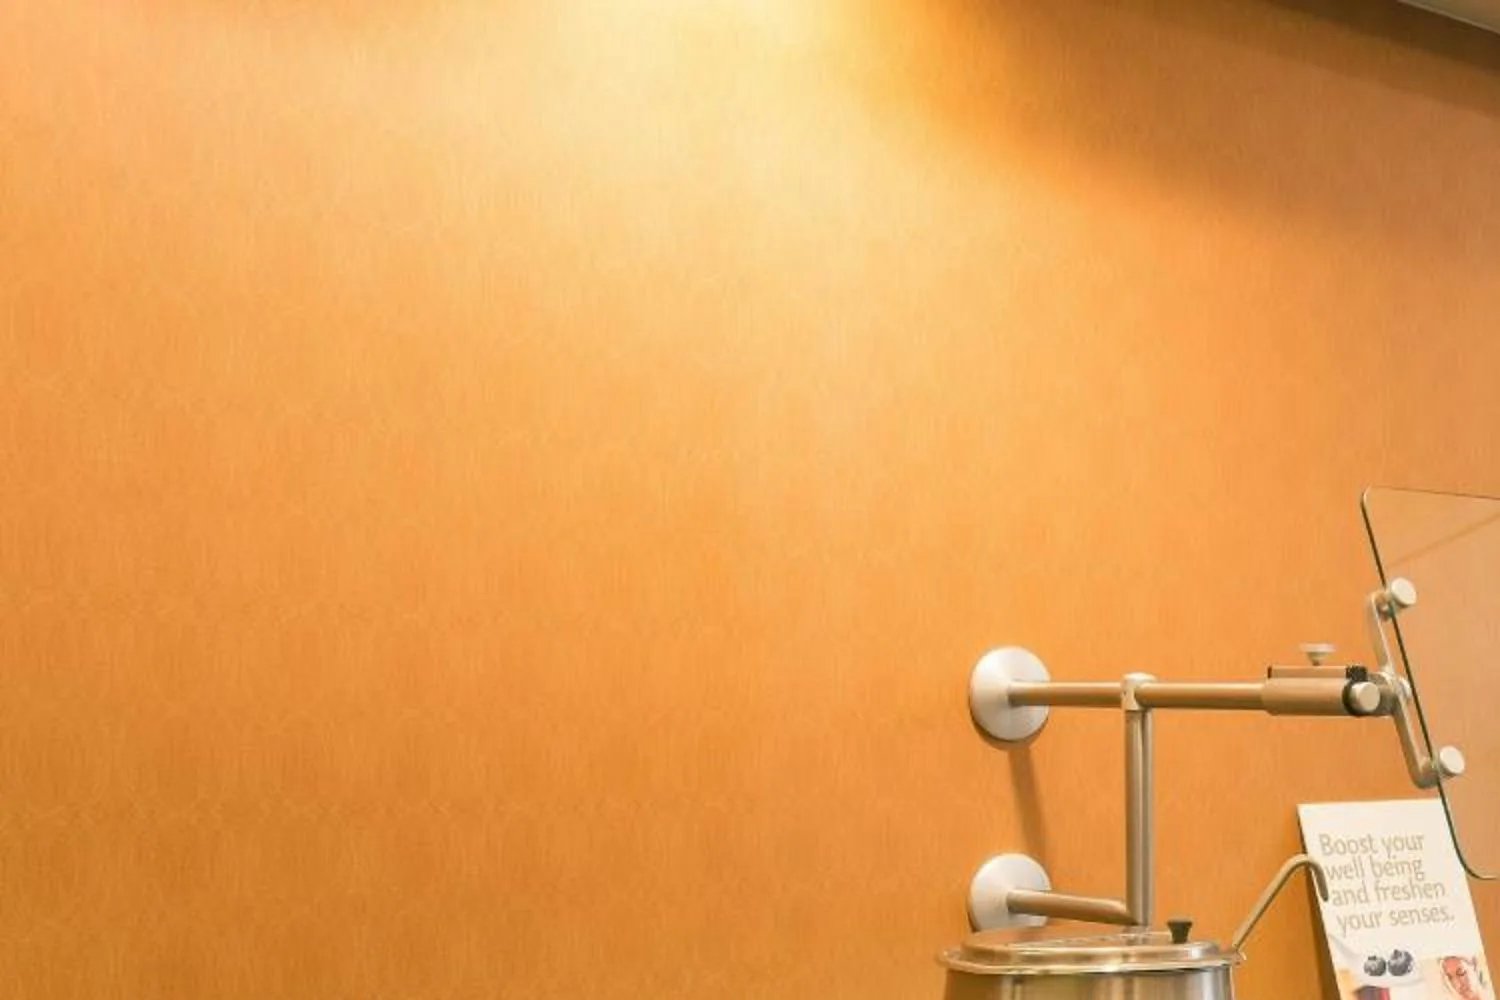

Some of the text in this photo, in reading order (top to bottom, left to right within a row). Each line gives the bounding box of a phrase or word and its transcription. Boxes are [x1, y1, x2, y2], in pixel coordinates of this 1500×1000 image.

[1319, 833, 1425, 860] Boost your
[1326, 855, 1426, 881] well being
[1332, 879, 1446, 907] and freshen
[1336, 911, 1383, 939] your
